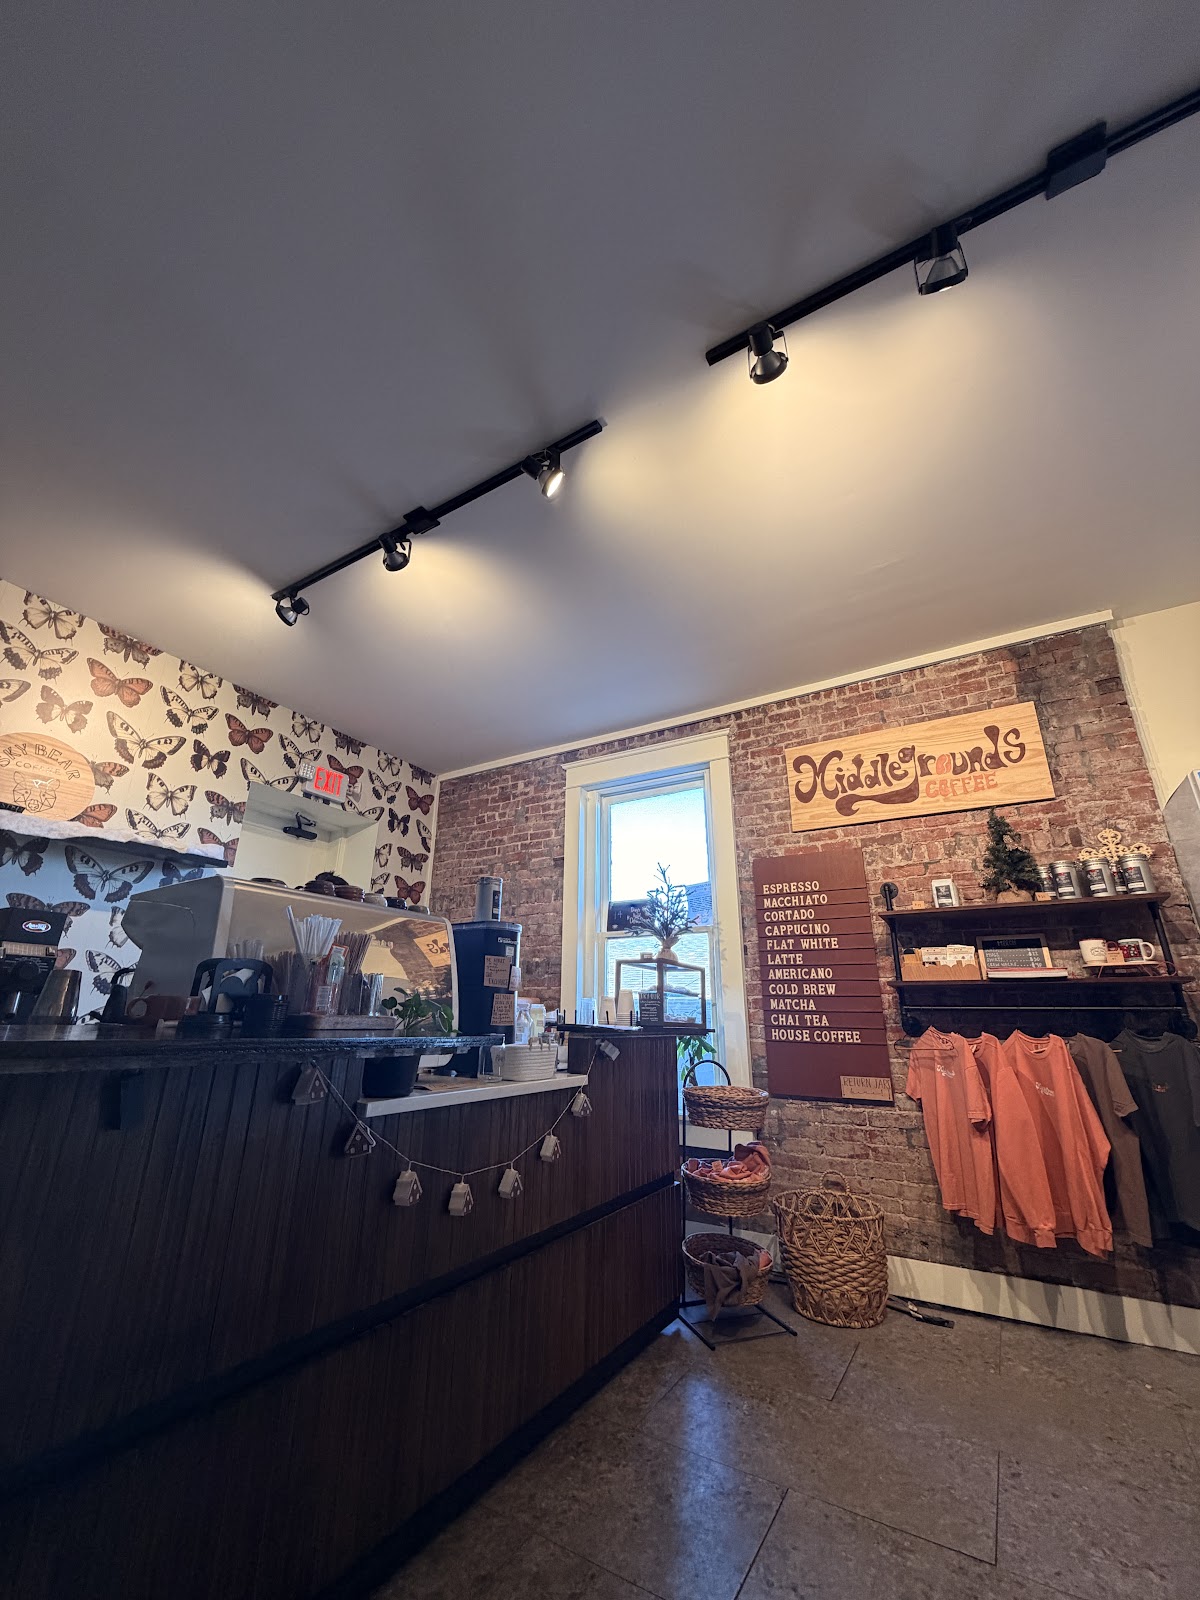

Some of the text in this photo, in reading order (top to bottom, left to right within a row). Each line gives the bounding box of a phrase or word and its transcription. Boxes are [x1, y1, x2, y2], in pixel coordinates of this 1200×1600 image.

[35, 743, 81, 781] BEAR
[792, 724, 1026, 817] Middlegrounds
[313, 765, 345, 798] EXIT
[924, 771, 999, 799] COFFEE
[762, 880, 820, 895] ESPRESSO
[763, 894, 829, 909] MACCHIATO
[763, 909, 815, 922] CORTADO
[765, 923, 830, 936] CAPPUCINO
[766, 937, 839, 951] FLAT WHITE
[767, 953, 804, 965] LATTE
[768, 967, 833, 980] AMERICANO
[768, 983, 836, 995] COLD BREW
[770, 998, 817, 1011] MATCHA
[770, 1013, 830, 1027] CHAI TEA
[771, 1028, 862, 1043] HOUSE COFFEE
[843, 1077, 872, 1089] RETURN
